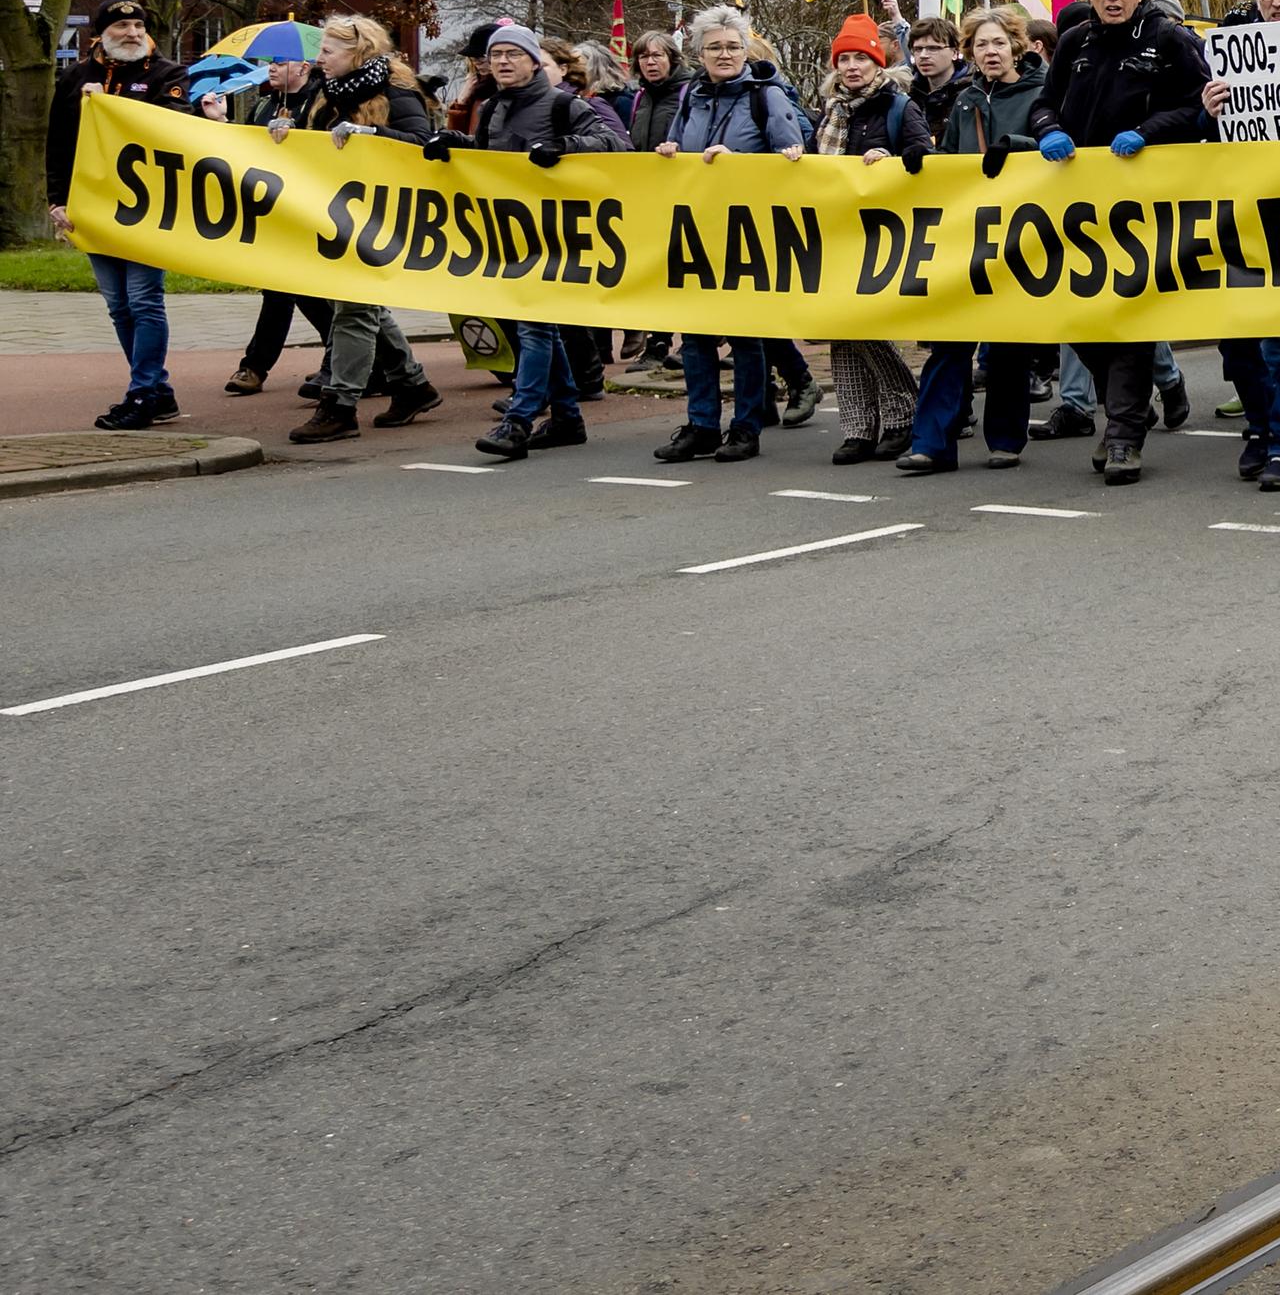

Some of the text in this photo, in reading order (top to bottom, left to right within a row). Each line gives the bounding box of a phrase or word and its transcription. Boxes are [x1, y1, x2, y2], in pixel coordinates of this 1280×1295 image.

[1222, 117, 1270, 141] VOOR
[114, 143, 284, 244] STOP
[316, 180, 627, 288] SUBSIDIES
[667, 204, 822, 294] AAN
[856, 207, 943, 296] DE
